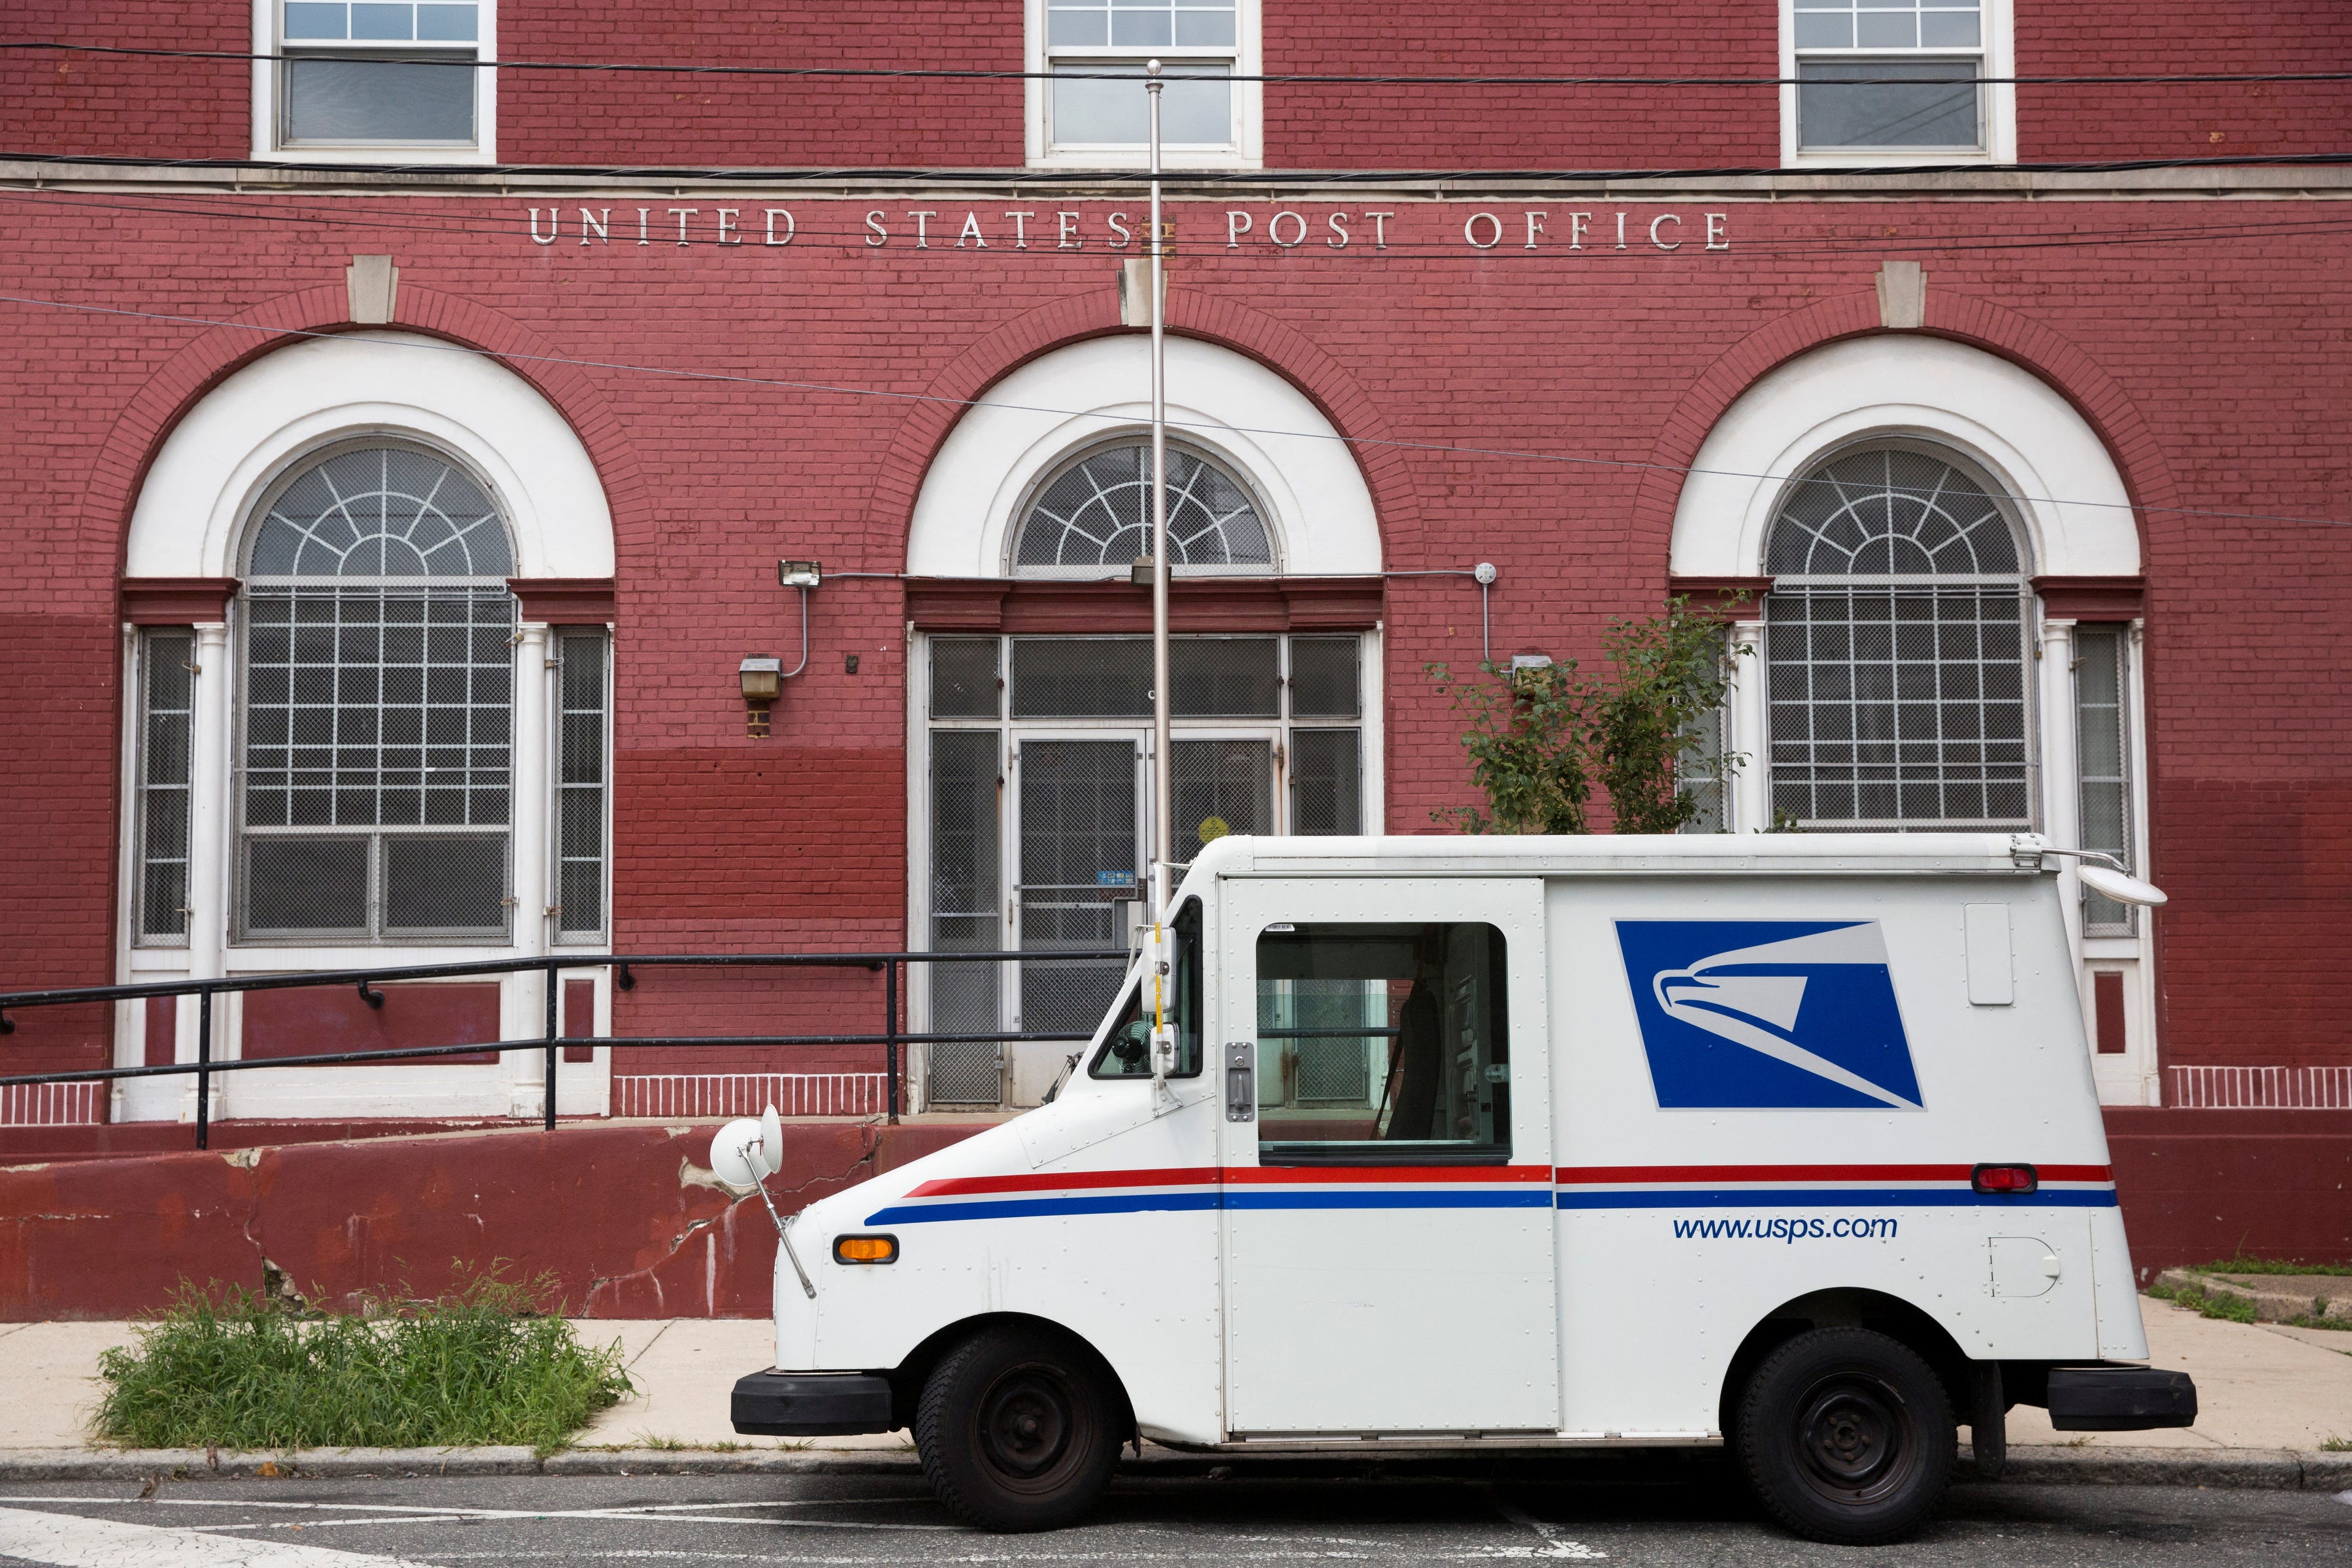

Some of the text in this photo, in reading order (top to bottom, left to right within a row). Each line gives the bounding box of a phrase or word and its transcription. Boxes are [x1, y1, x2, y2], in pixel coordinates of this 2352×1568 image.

[528, 208, 1730, 250] UNITED STATES POST OFFICE
[1673, 1218, 1898, 1245] www.usps.com
